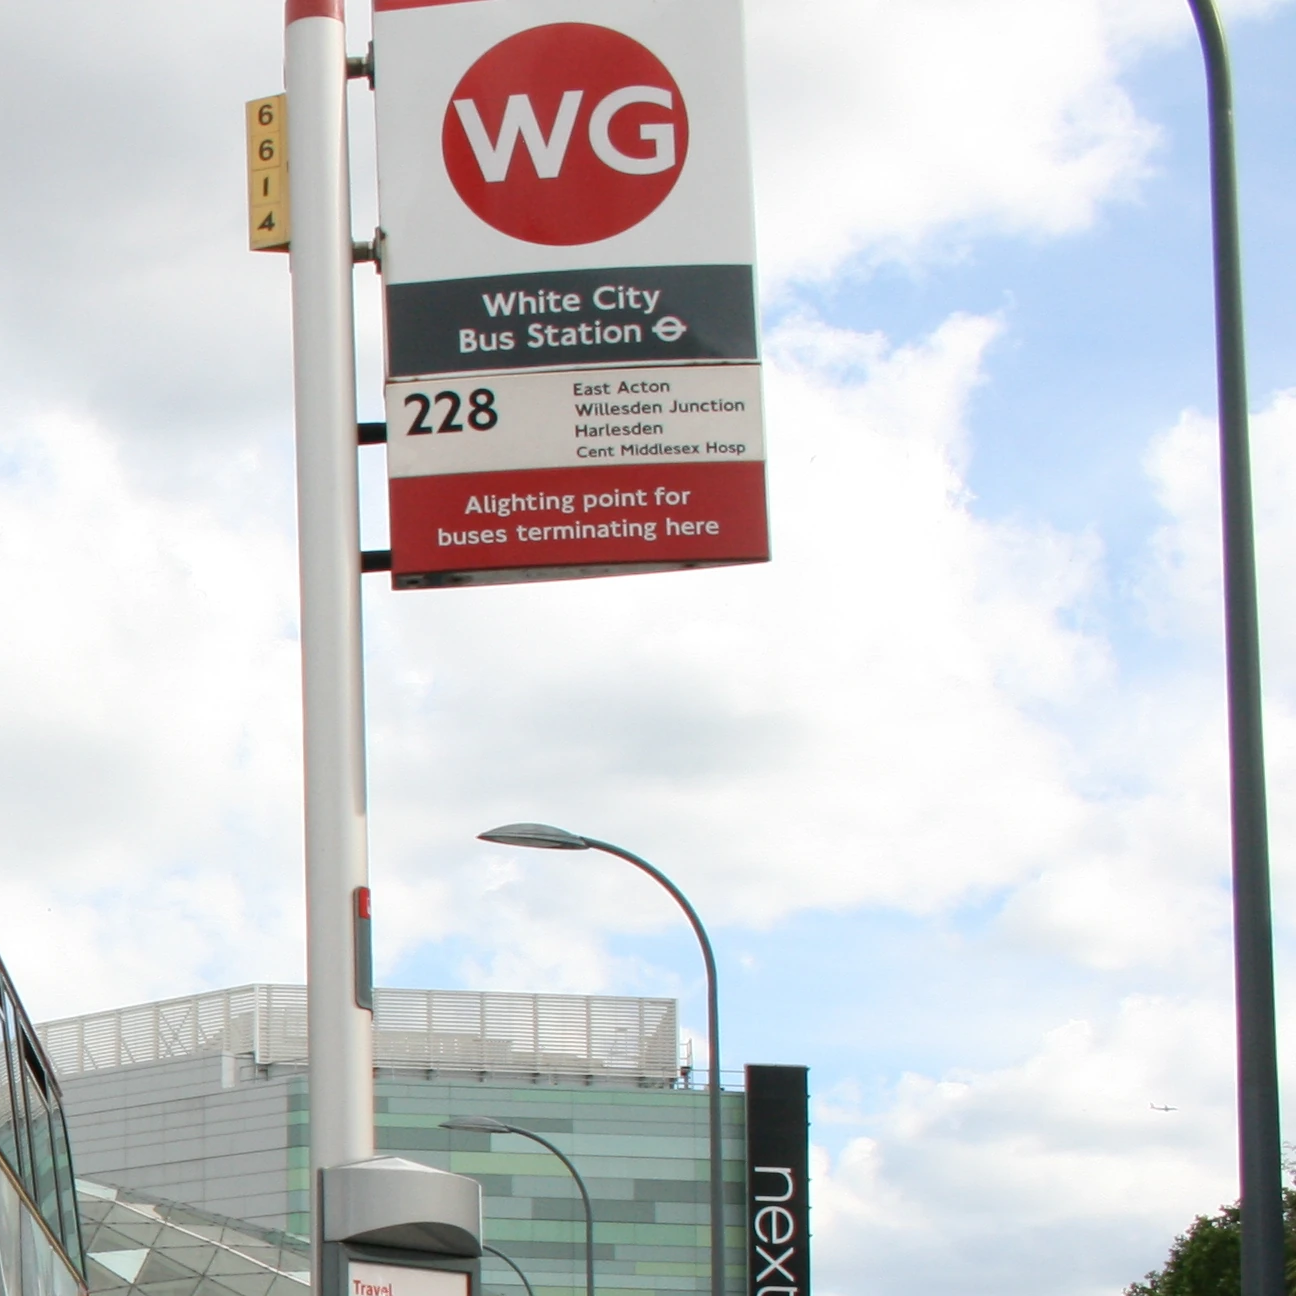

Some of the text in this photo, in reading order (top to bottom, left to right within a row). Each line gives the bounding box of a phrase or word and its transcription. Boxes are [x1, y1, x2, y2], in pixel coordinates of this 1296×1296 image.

[453, 85, 677, 184] WG
[482, 285, 660, 318] White City
[459, 319, 642, 353] Bus Station
[573, 381, 670, 396] East Acton
[404, 388, 498, 436] 228
[575, 399, 745, 417] Willesden Junction
[575, 422, 663, 437] Harlesden
[576, 442, 746, 458] Cent Middlesex Hosp
[465, 487, 690, 517] Alighting point for
[437, 518, 719, 547] buses terminating here
